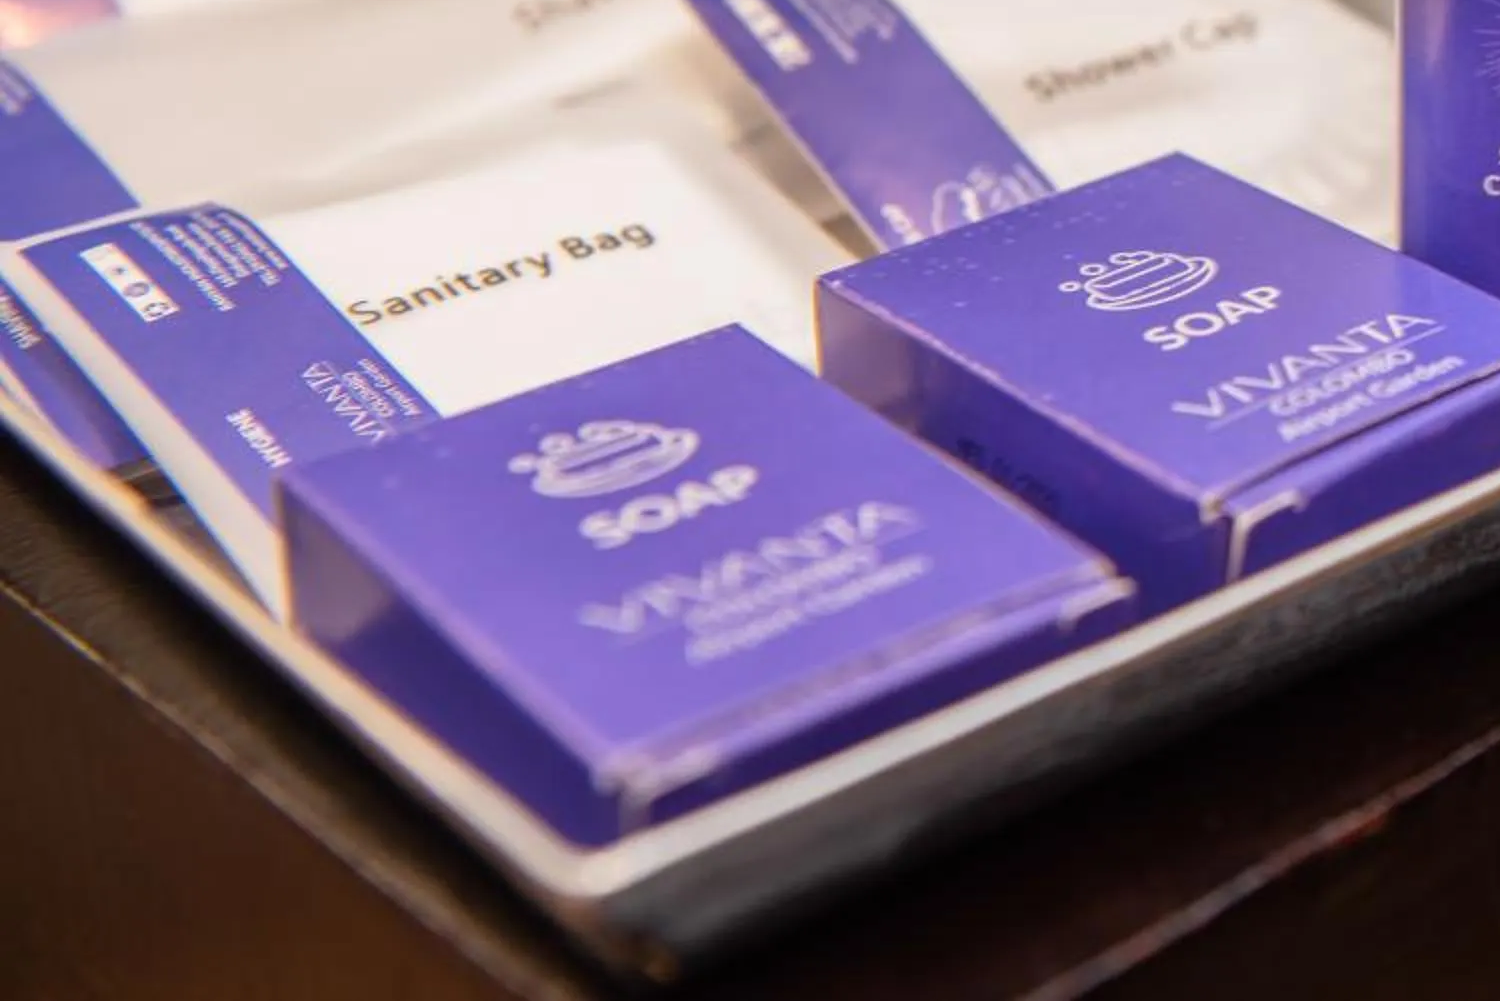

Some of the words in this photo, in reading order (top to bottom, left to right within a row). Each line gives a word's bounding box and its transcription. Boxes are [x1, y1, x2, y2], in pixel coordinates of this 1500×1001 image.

[1022, 35, 1175, 104] Shower
[1178, 9, 1259, 52] Cap
[346, 251, 552, 326] Sanitary
[559, 222, 656, 260] Bag
[1143, 285, 1282, 351] SOAP
[300, 361, 388, 445] VIVANTA
[1171, 313, 1437, 417] VIVANTA
[1269, 349, 1416, 415] COLOMBO
[1277, 393, 1374, 442] Airport
[1367, 355, 1466, 397] Garden
[579, 464, 758, 550] SOAP
[576, 500, 926, 634] VIVANTA
